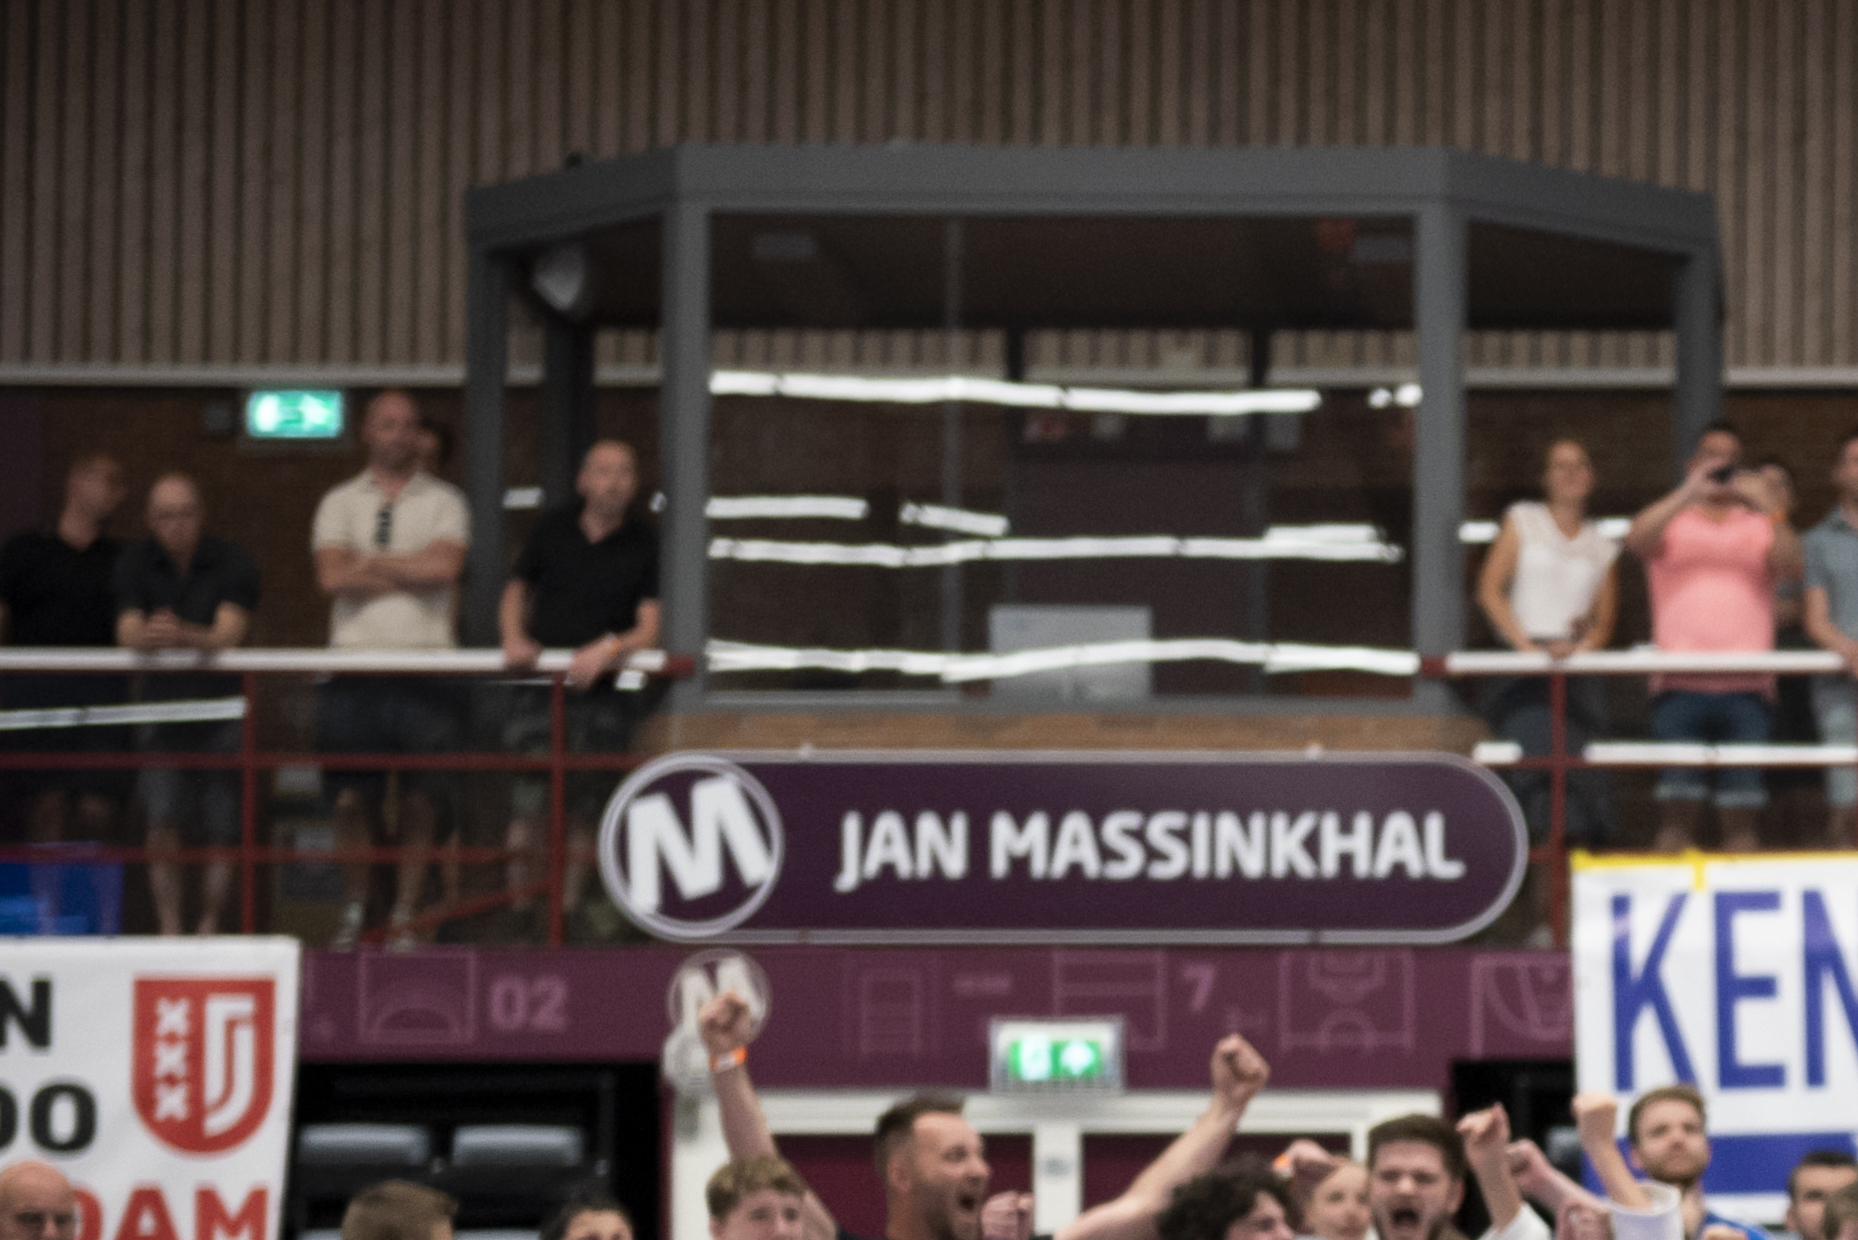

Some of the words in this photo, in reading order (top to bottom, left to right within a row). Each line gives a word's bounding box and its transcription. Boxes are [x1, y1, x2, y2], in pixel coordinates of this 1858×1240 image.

[835, 811, 967, 892] JAN
[991, 810, 1465, 880] MASSINKHAL
[490, 972, 568, 1033] 02
